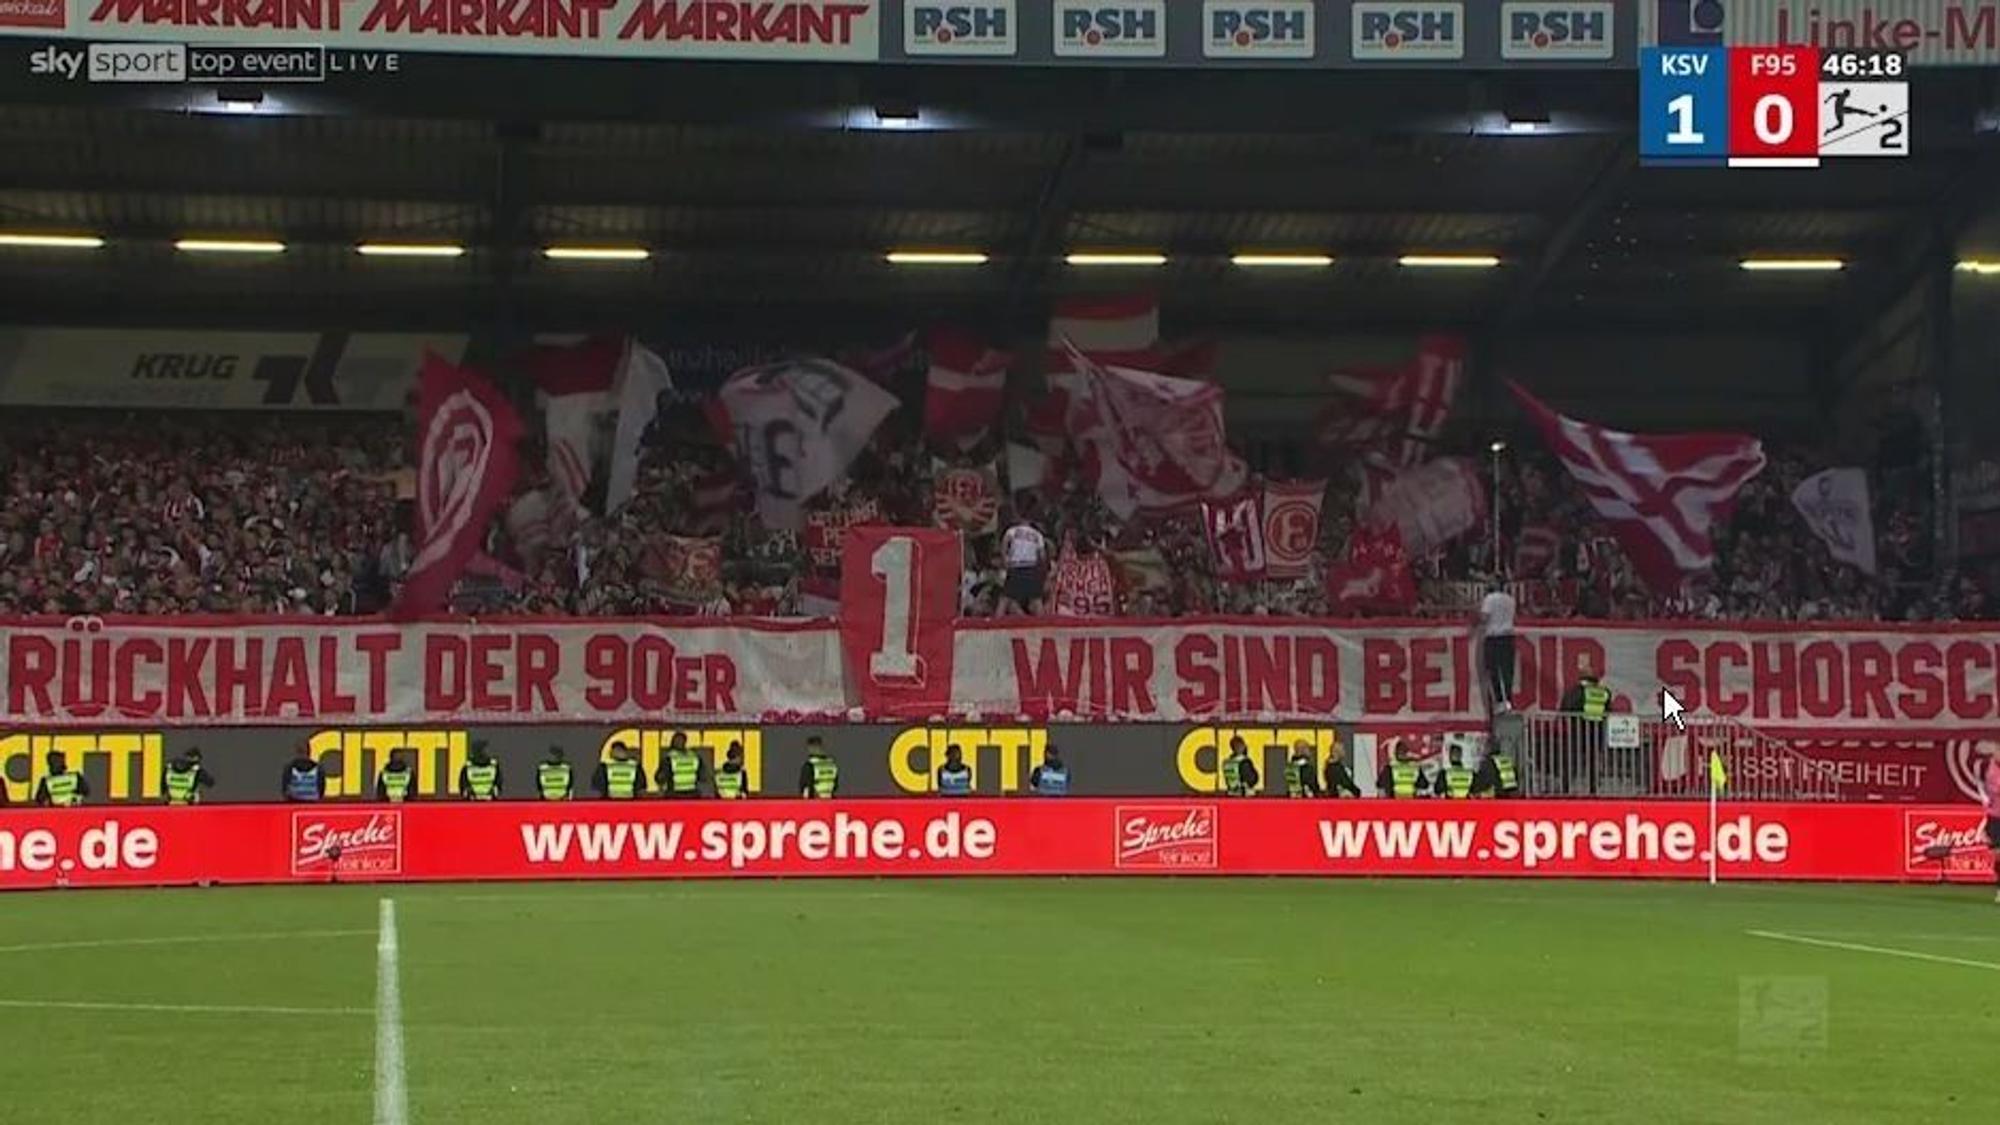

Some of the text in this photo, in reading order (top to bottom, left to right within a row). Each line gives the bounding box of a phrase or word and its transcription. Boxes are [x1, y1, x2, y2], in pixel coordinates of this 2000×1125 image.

[88, 0, 357, 31] MARKANT
[358, 0, 617, 38] MARKANT
[617, 1, 869, 43] MARKANT
[914, 7, 1006, 37] RSH
[1063, 9, 1155, 39] RSH
[1213, 10, 1306, 39] RSH
[1362, 11, 1455, 41] RSH
[1511, 12, 1604, 42] RSH
[1777, 5, 1997, 48] Linke-M
[132, 354, 240, 380] KRUG
[869, 536, 927, 688] 1
[8, 616, 737, 717] RÜCKHALT DER 90ER
[1012, 636, 1156, 714] WIR
[1175, 632, 1340, 714] SIND
[1362, 635, 1470, 713] BEI
[1655, 638, 2000, 720] SCHORSC
[0, 733, 162, 803] CITTI
[309, 730, 467, 796] CITTI
[889, 728, 1047, 792] CITTI
[1802, 759, 1927, 788] FREIHEIT
[300, 813, 394, 858] Sprehe
[521, 812, 996, 867] www.sprehe.de
[1123, 808, 1211, 851] Sprehe
[1319, 814, 1789, 867] www.sprehe.de
[1912, 816, 1989, 853] Spreh
